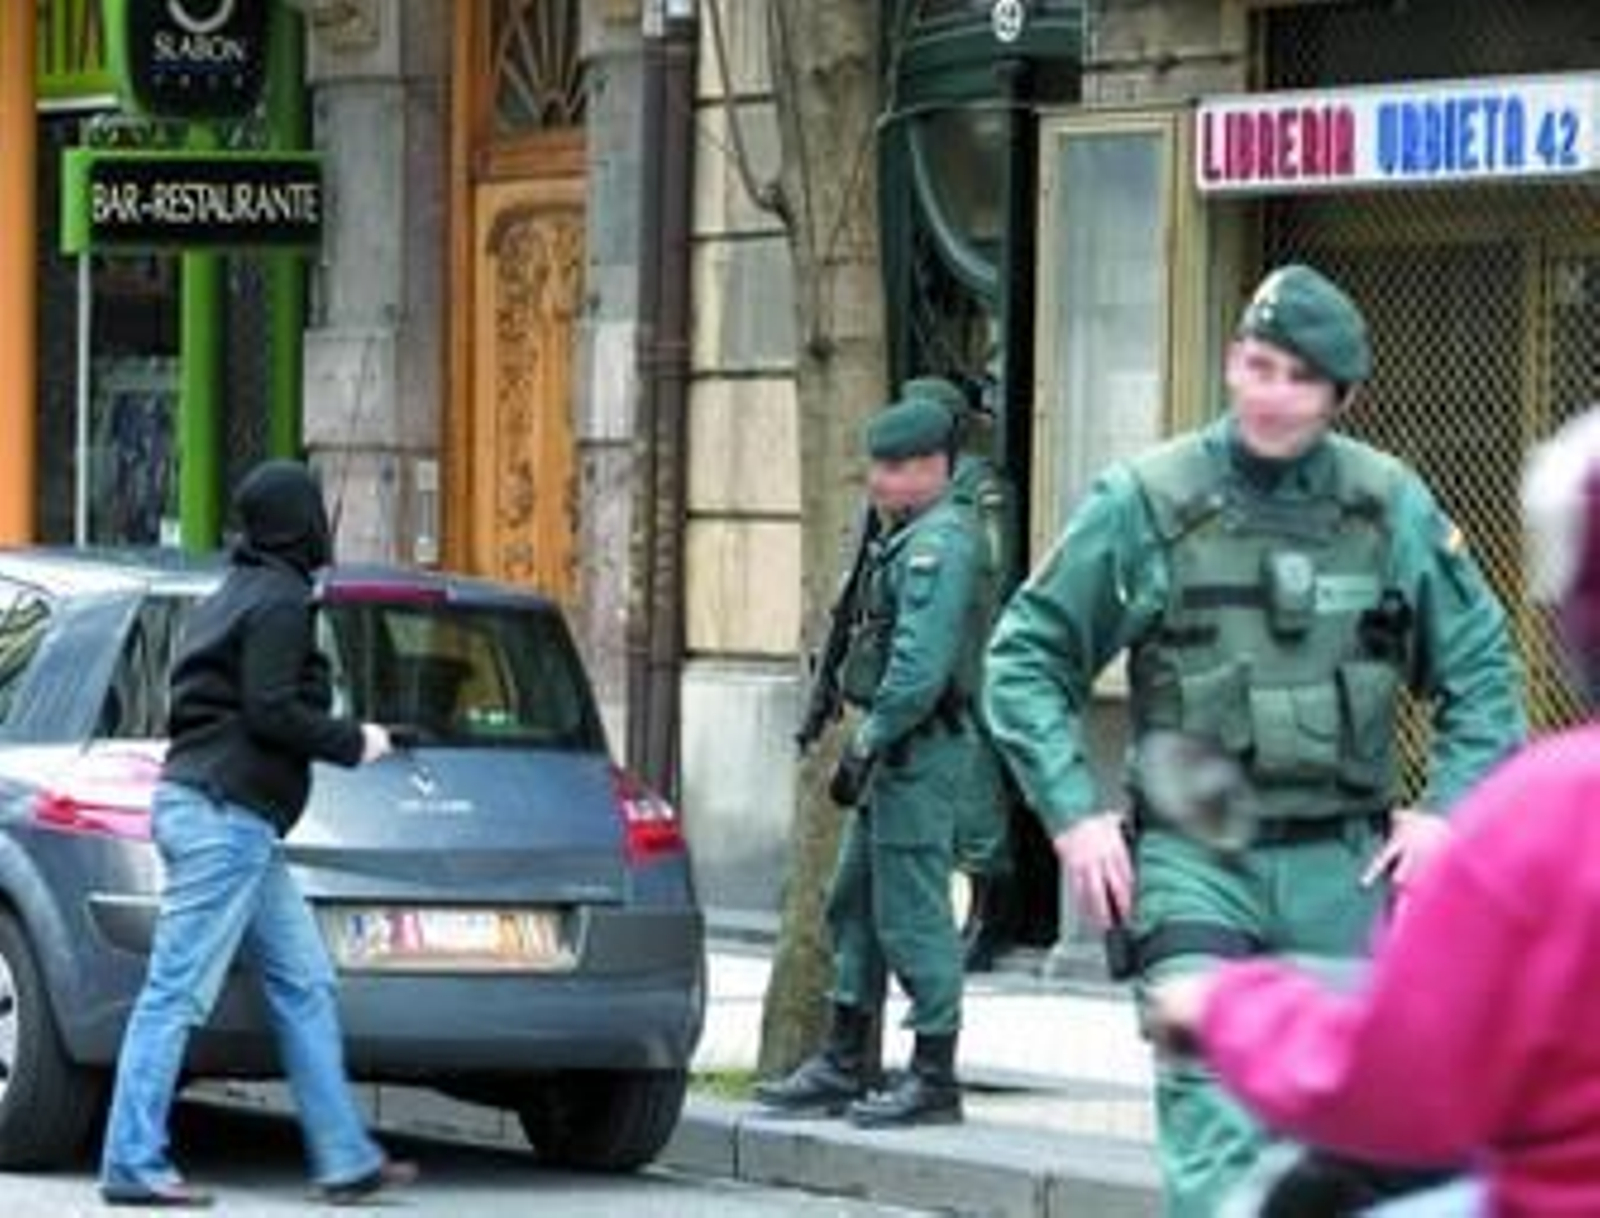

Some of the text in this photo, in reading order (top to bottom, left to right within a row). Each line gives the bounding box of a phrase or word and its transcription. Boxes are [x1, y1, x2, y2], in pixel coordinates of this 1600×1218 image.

[1202, 96, 1580, 181] LIBRERIA URBIETA 42
[92, 182, 319, 224] BAR-RESTAURANTE
